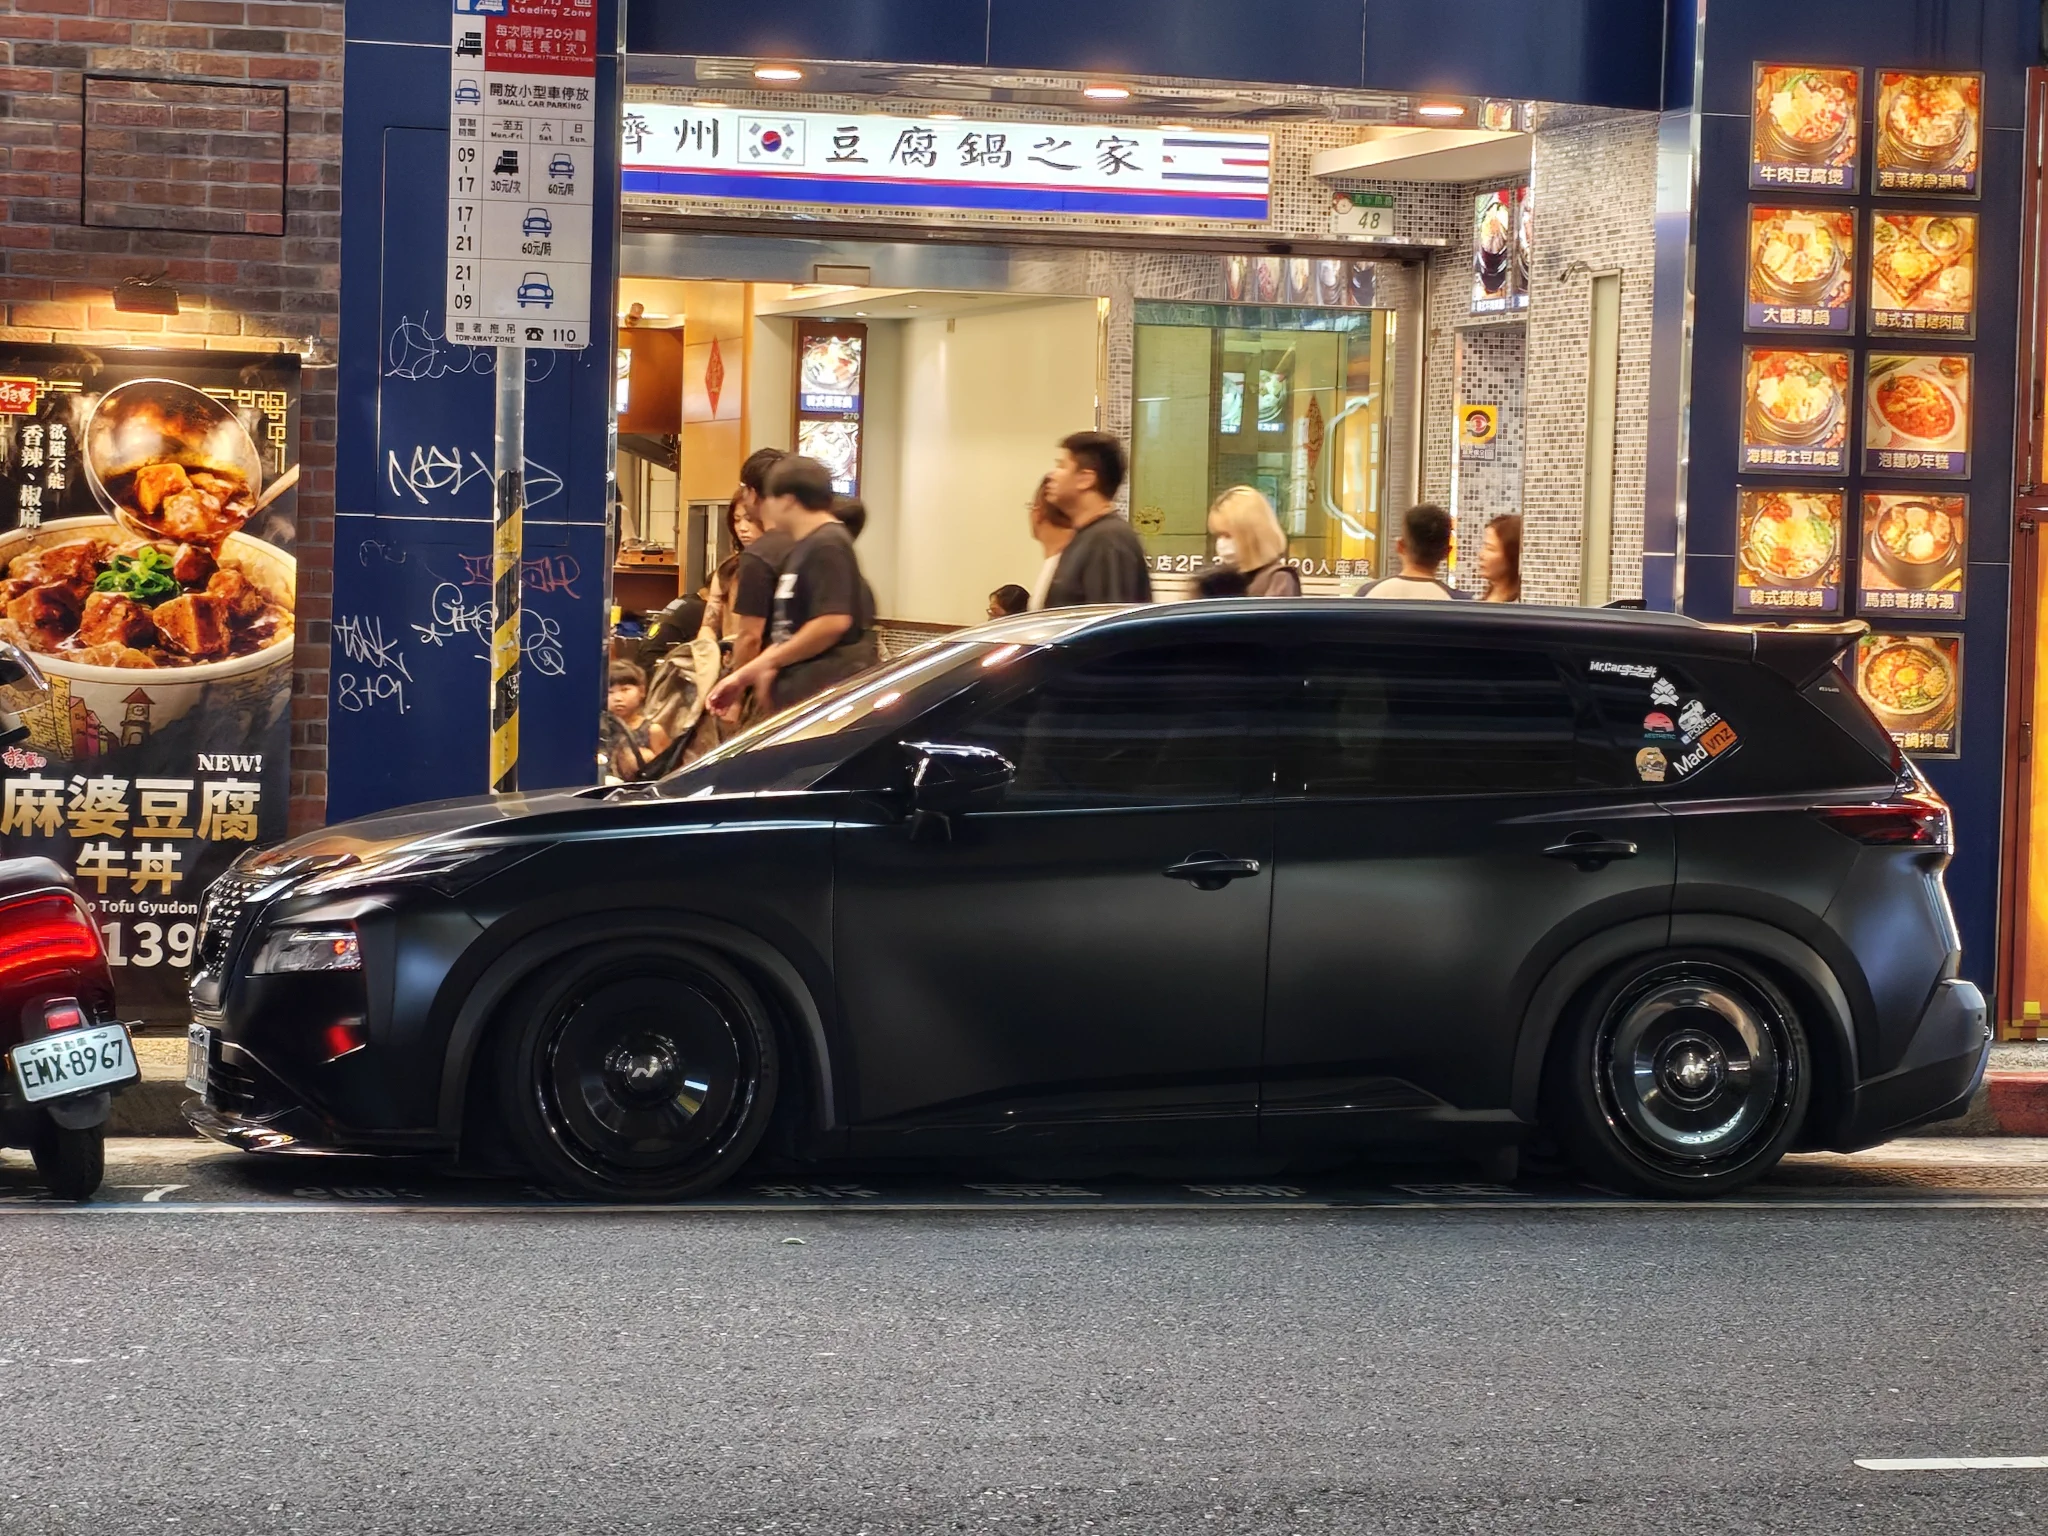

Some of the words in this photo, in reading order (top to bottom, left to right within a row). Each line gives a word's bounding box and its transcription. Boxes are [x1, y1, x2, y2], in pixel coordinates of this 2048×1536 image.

[511, 5, 557, 17] Loading
[563, 7, 592, 17] Zone
[489, 82, 590, 101] 開放小型車停放
[497, 98, 526, 107] SMALL
[528, 100, 545, 108] CAR
[547, 101, 582, 110] PARKING
[492, 120, 523, 131] 一至五
[541, 122, 552, 132] 六
[574, 123, 583, 134] 日
[458, 147, 475, 163] 09
[825, 124, 1145, 176] 豆腐鍋之家
[1759, 165, 1844, 185] 牛肉豆腐煲
[458, 176, 475, 193] 17
[490, 179, 521, 194] 30元/次
[548, 182, 575, 197] 60元/時
[457, 206, 474, 222] 17
[1357, 211, 1381, 230] 48
[456, 235, 472, 252] 21
[521, 240, 552, 256] 60元/時
[455, 265, 471, 281] 21
[454, 294, 472, 310] 09
[1763, 308, 1831, 326] 大醬湯鍋
[455, 322, 516, 334] 違者拖吊
[553, 328, 576, 342] 110
[455, 334, 493, 343] TOW-AWAY
[495, 335, 516, 344] ZONE
[843, 412, 860, 420] 270
[48, 423, 67, 490] 欲罷不能
[1746, 448, 1840, 467] 海鮮起士豆腐煲
[1749, 589, 1823, 607] 韓式部隊鍋
[1864, 592, 1955, 610] 馬鈴薯排骨湯
[1643, 732, 1677, 740] AESTHETIC
[1890, 732, 1949, 748] 石鍋拌飯
[197, 753, 263, 773] NEW!
[1672, 743, 1709, 776] Mad
[1, 773, 262, 842] 麻婆豆腐
[74, 842, 183, 896] 牛丼
[99, 899, 135, 914] Tofu
[138, 900, 198, 917] Gyudon
[101, 921, 196, 968] 139
[19, 1039, 123, 1089] EMX-8967
